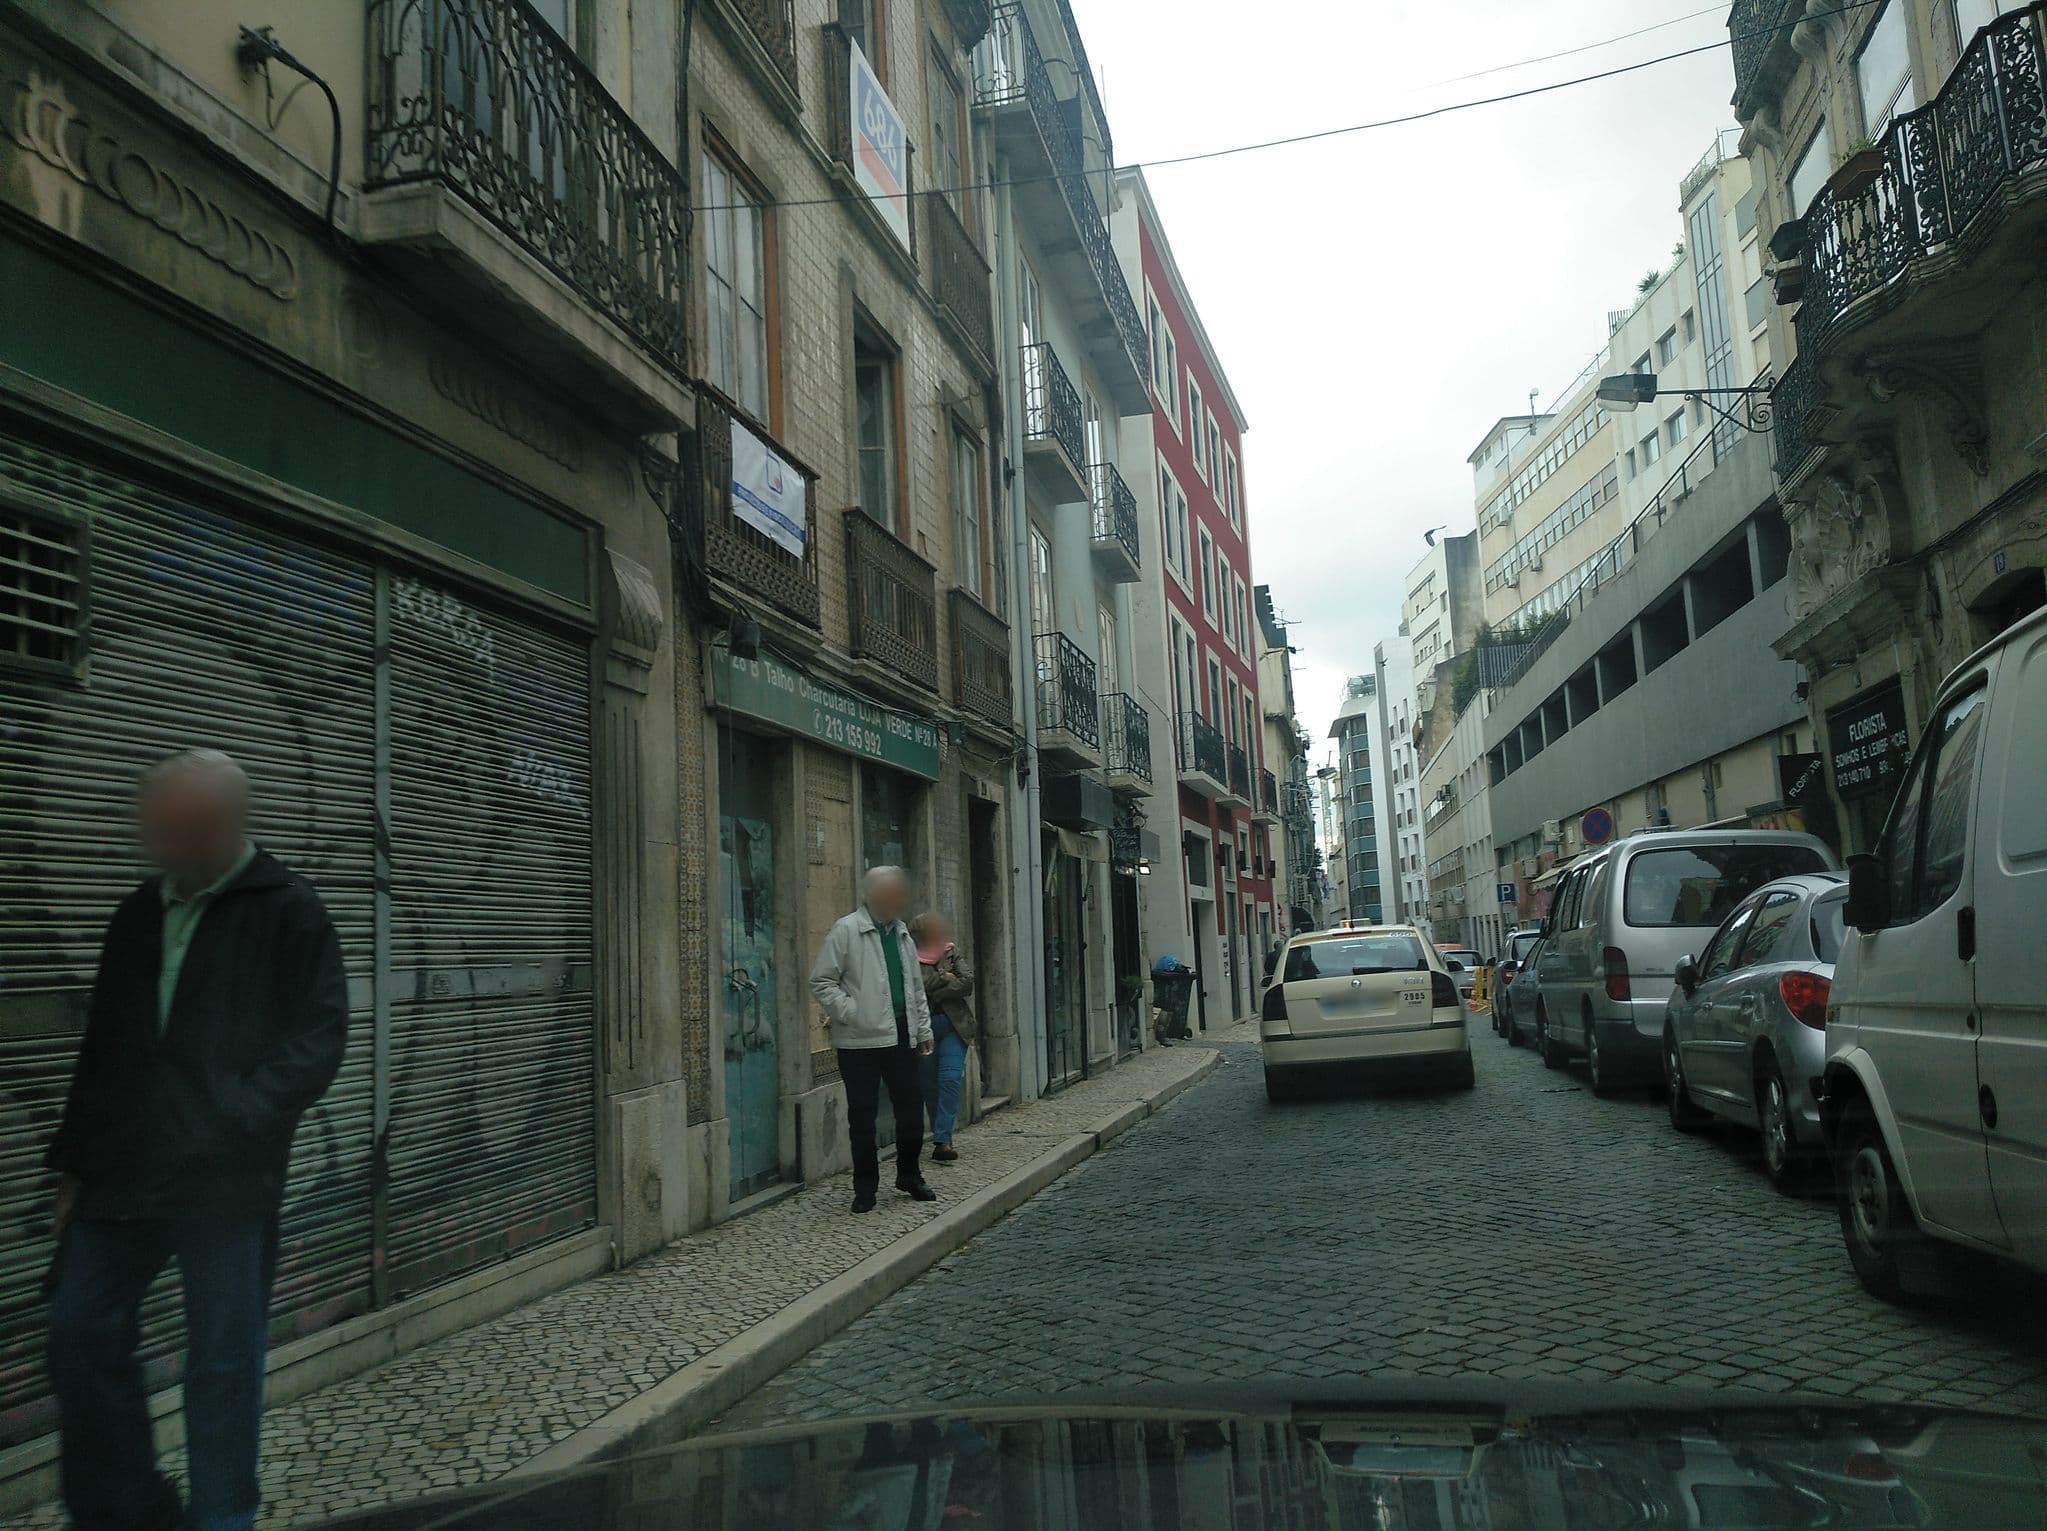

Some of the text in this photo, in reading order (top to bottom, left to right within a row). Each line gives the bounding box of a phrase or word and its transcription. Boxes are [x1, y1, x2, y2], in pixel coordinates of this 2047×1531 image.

[764, 661, 794, 692] Talho
[799, 676, 856, 716] Charcutaria
[886, 714, 912, 740] VERDE
[825, 715, 882, 755] 213 155 992
[1849, 712, 1887, 743] FLORISTA
[1835, 748, 1860, 769] SONHOS
[1862, 745, 1868, 759] E
